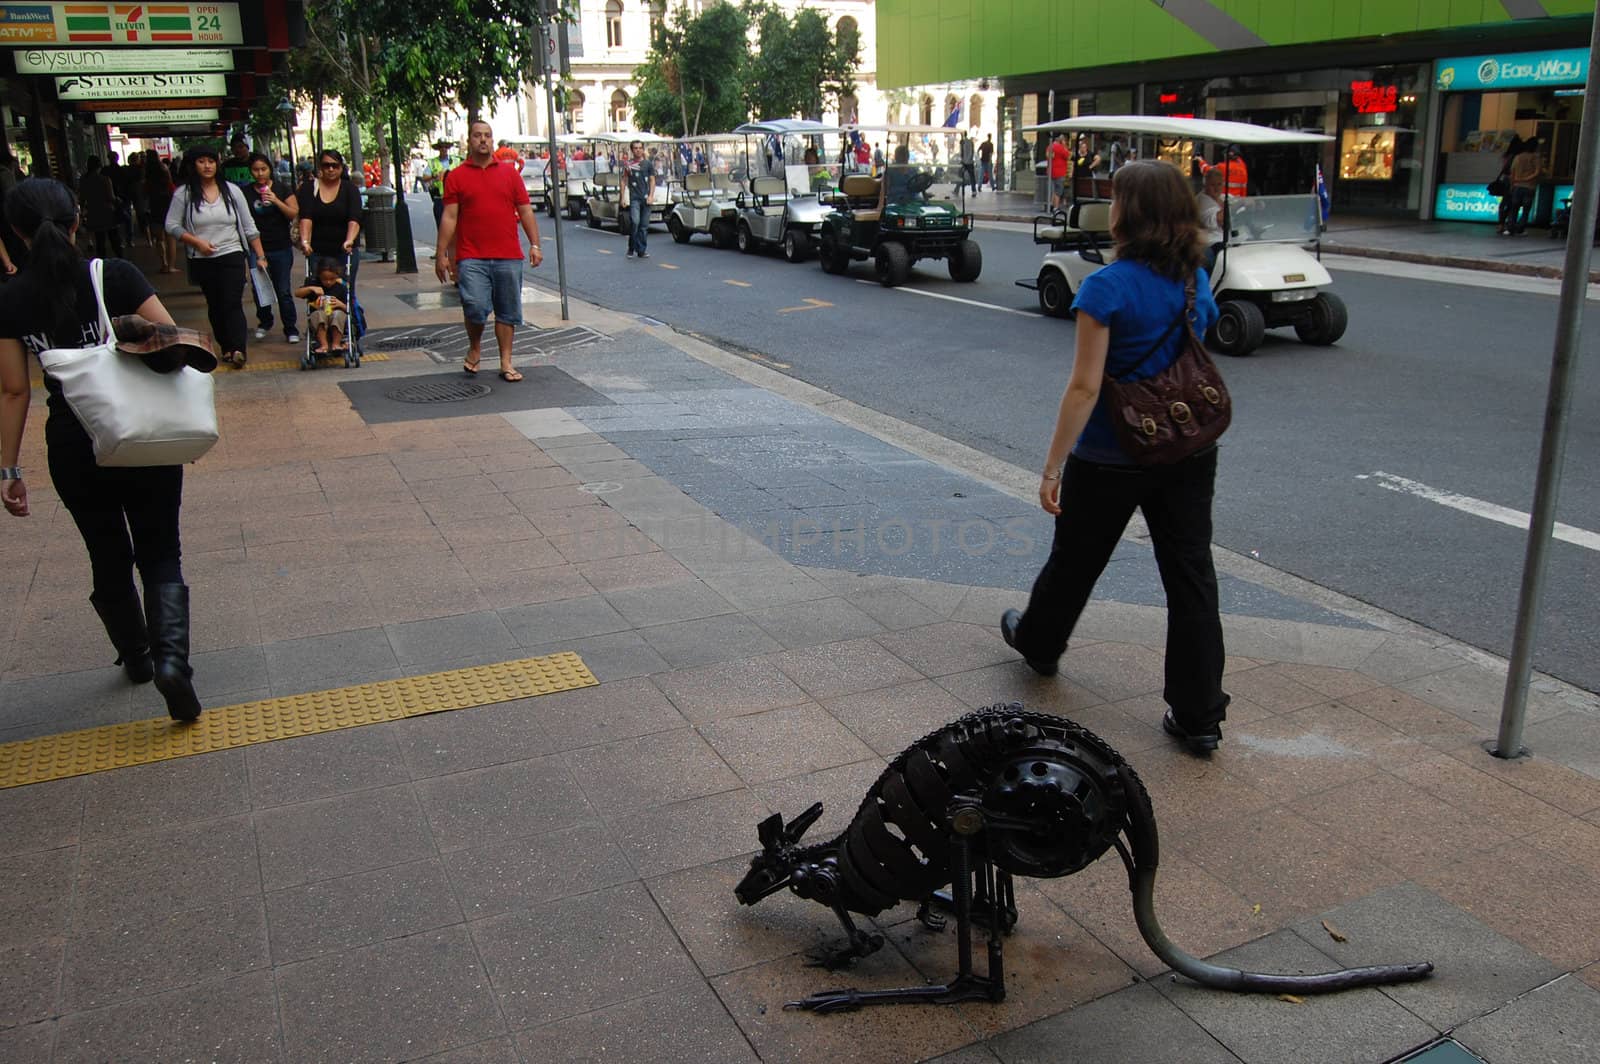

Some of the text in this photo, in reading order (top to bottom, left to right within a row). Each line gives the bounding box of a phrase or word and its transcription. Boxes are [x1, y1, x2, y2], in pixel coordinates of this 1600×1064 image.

[10, 12, 50, 20] BankWest
[197, 16, 221, 31] 24
[0, 28, 34, 37] ATM
[198, 33, 224, 41] HOURS
[25, 50, 105, 71] elysium
[1501, 60, 1581, 80] EasyWay
[79, 74, 205, 89] STUART SUITS
[1446, 200, 1499, 215] Tea Indulg
